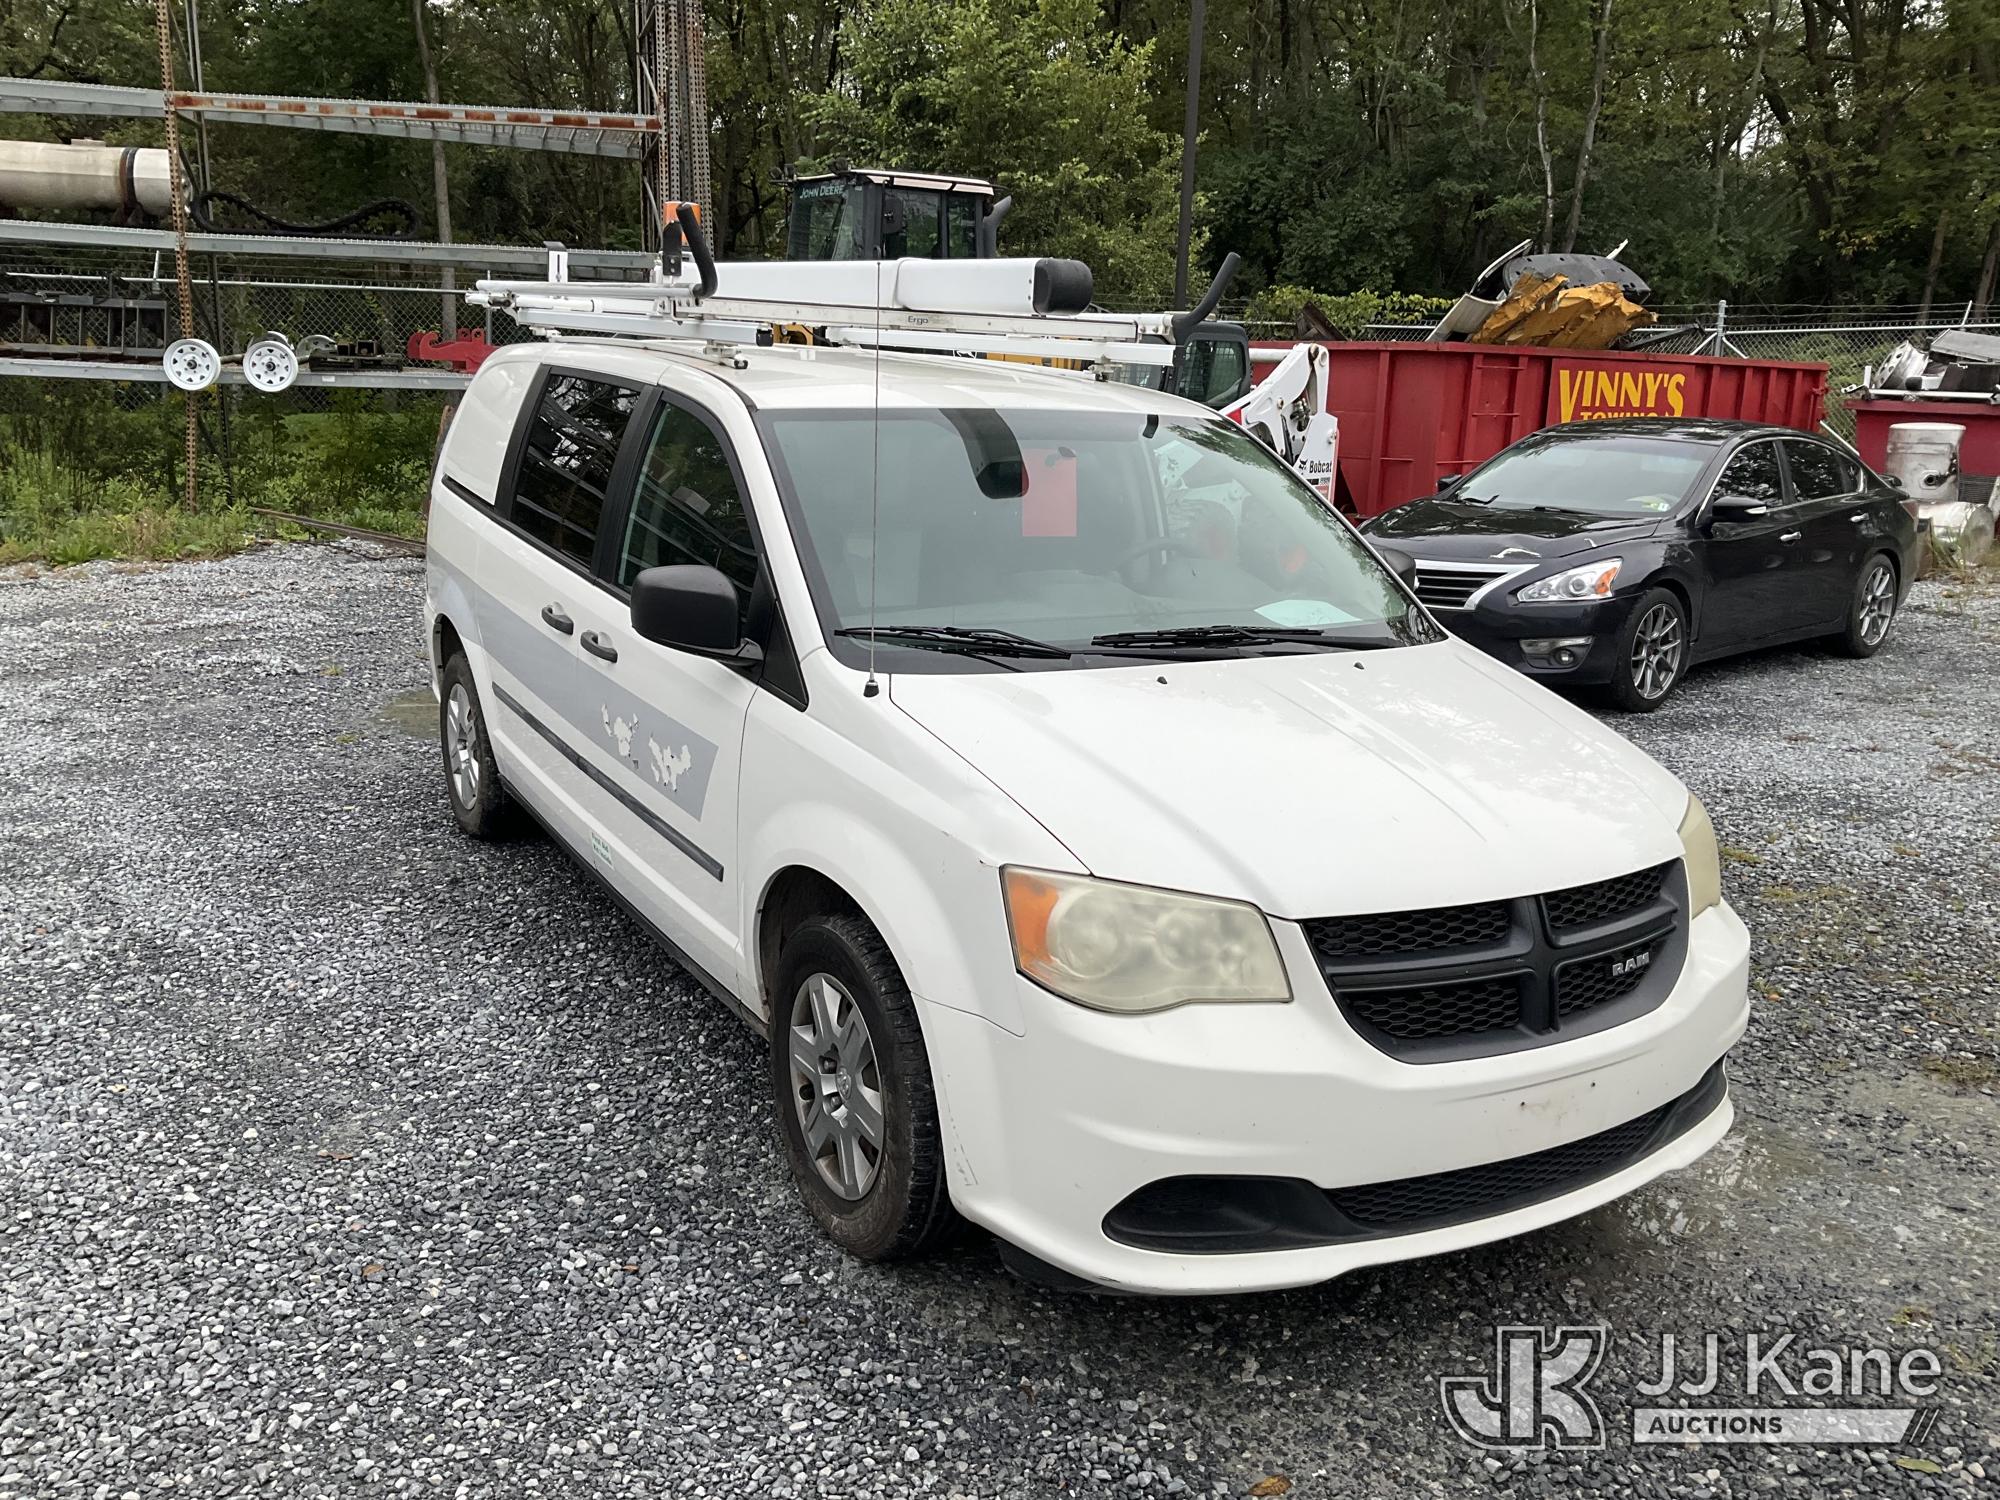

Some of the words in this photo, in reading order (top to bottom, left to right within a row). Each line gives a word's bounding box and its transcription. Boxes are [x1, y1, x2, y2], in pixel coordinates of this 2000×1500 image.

[800, 187, 819, 199] JOHN
[820, 184, 845, 196] DEERE
[908, 315, 928, 325] Ergo
[1560, 369, 1686, 423] VINNY'S
[1309, 460, 1332, 473] Bobcat
[1612, 951, 1650, 976] RAM
